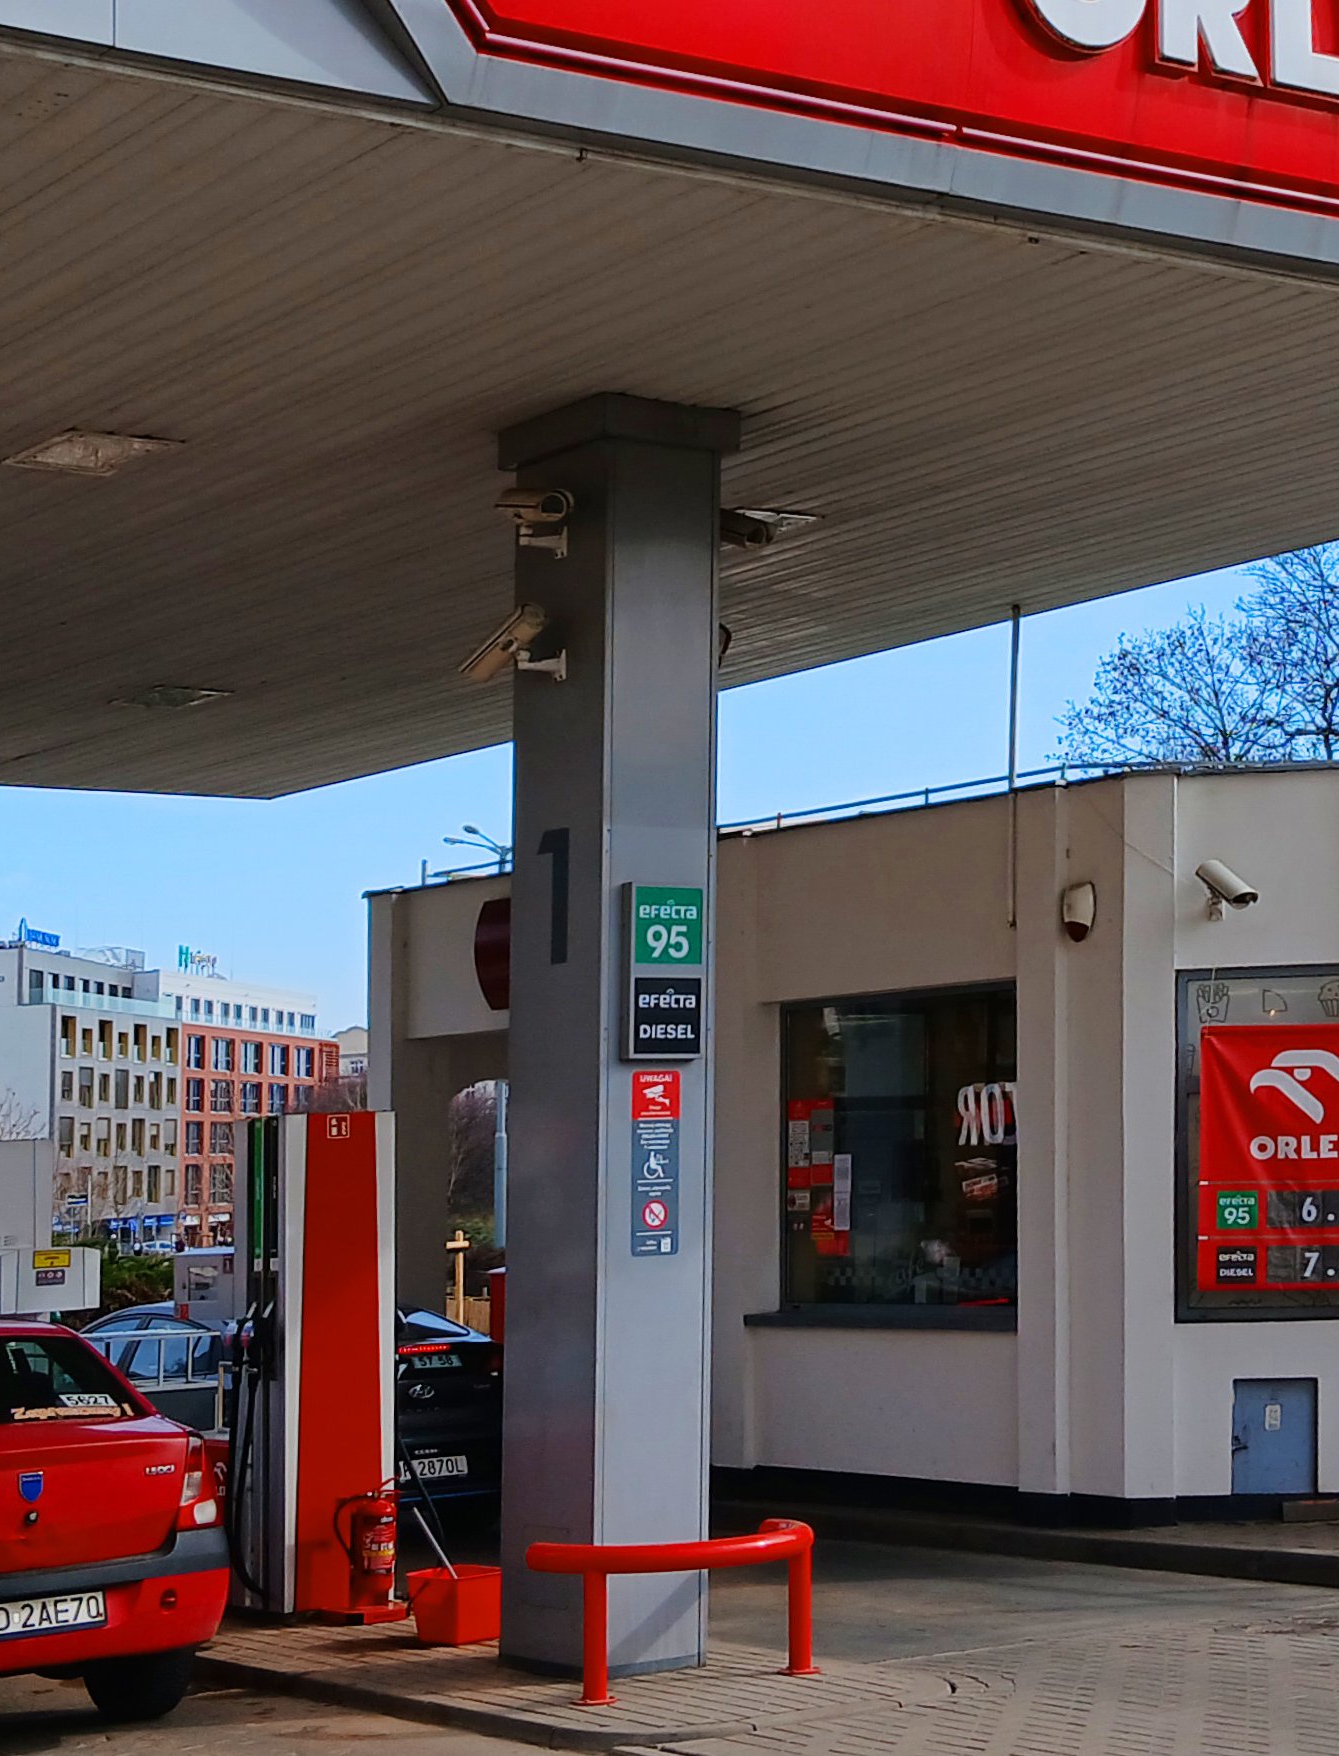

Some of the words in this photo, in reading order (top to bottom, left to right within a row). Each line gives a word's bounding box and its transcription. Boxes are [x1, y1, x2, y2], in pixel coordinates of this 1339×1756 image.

[537, 828, 570, 965] 1
[646, 924, 689, 959] 95
[639, 1024, 696, 1039] DIESEL
[1224, 1207, 1250, 1225] 95
[1219, 1268, 1254, 1277] DIESEL
[418, 1458, 465, 1477] 2870L
